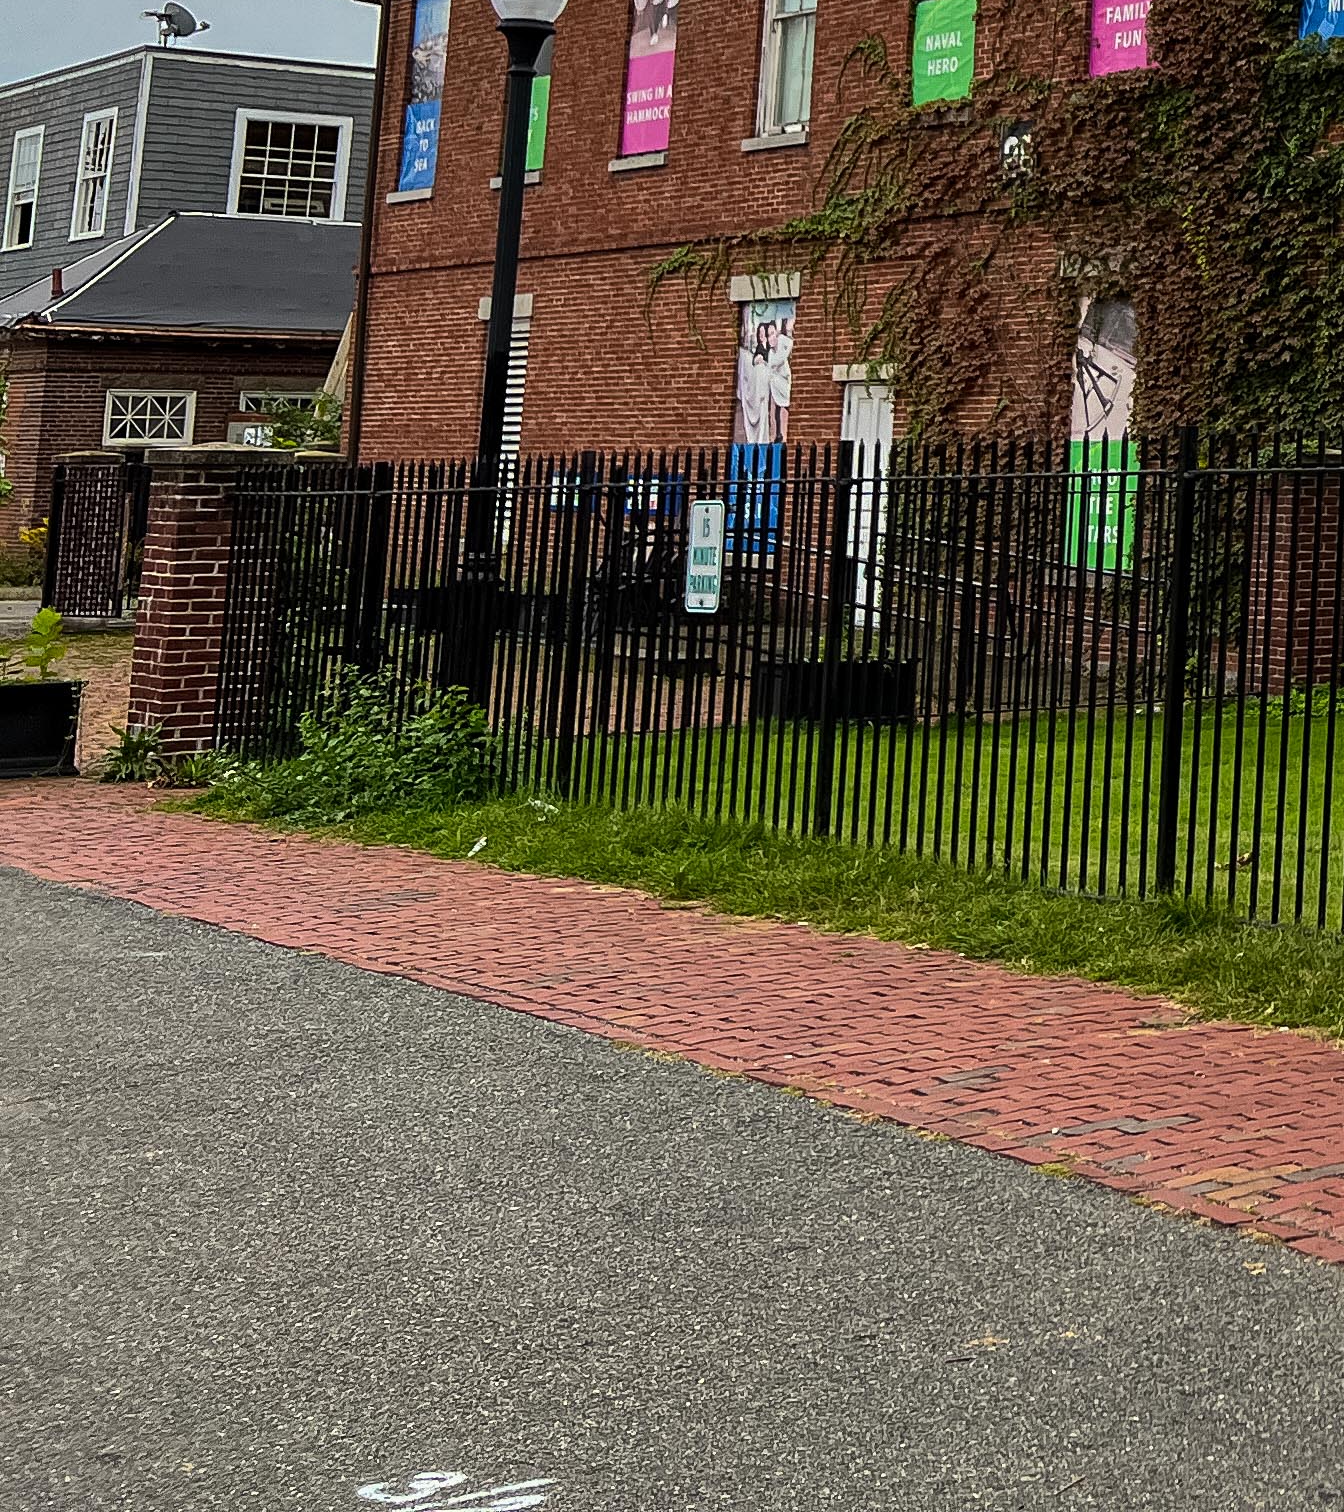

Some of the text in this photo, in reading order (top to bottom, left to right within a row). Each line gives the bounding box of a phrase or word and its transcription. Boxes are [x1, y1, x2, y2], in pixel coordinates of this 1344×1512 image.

[925, 30, 963, 52] NAVAL
[1114, 29, 1143, 50] FUN
[927, 56, 959, 77] HERO
[626, 84, 673, 105] SWING IN A
[626, 105, 671, 125] HAMMOCK
[415, 118, 436, 134] BACK
[419, 138, 429, 152] TO
[1087, 524, 1118, 543] TRS
